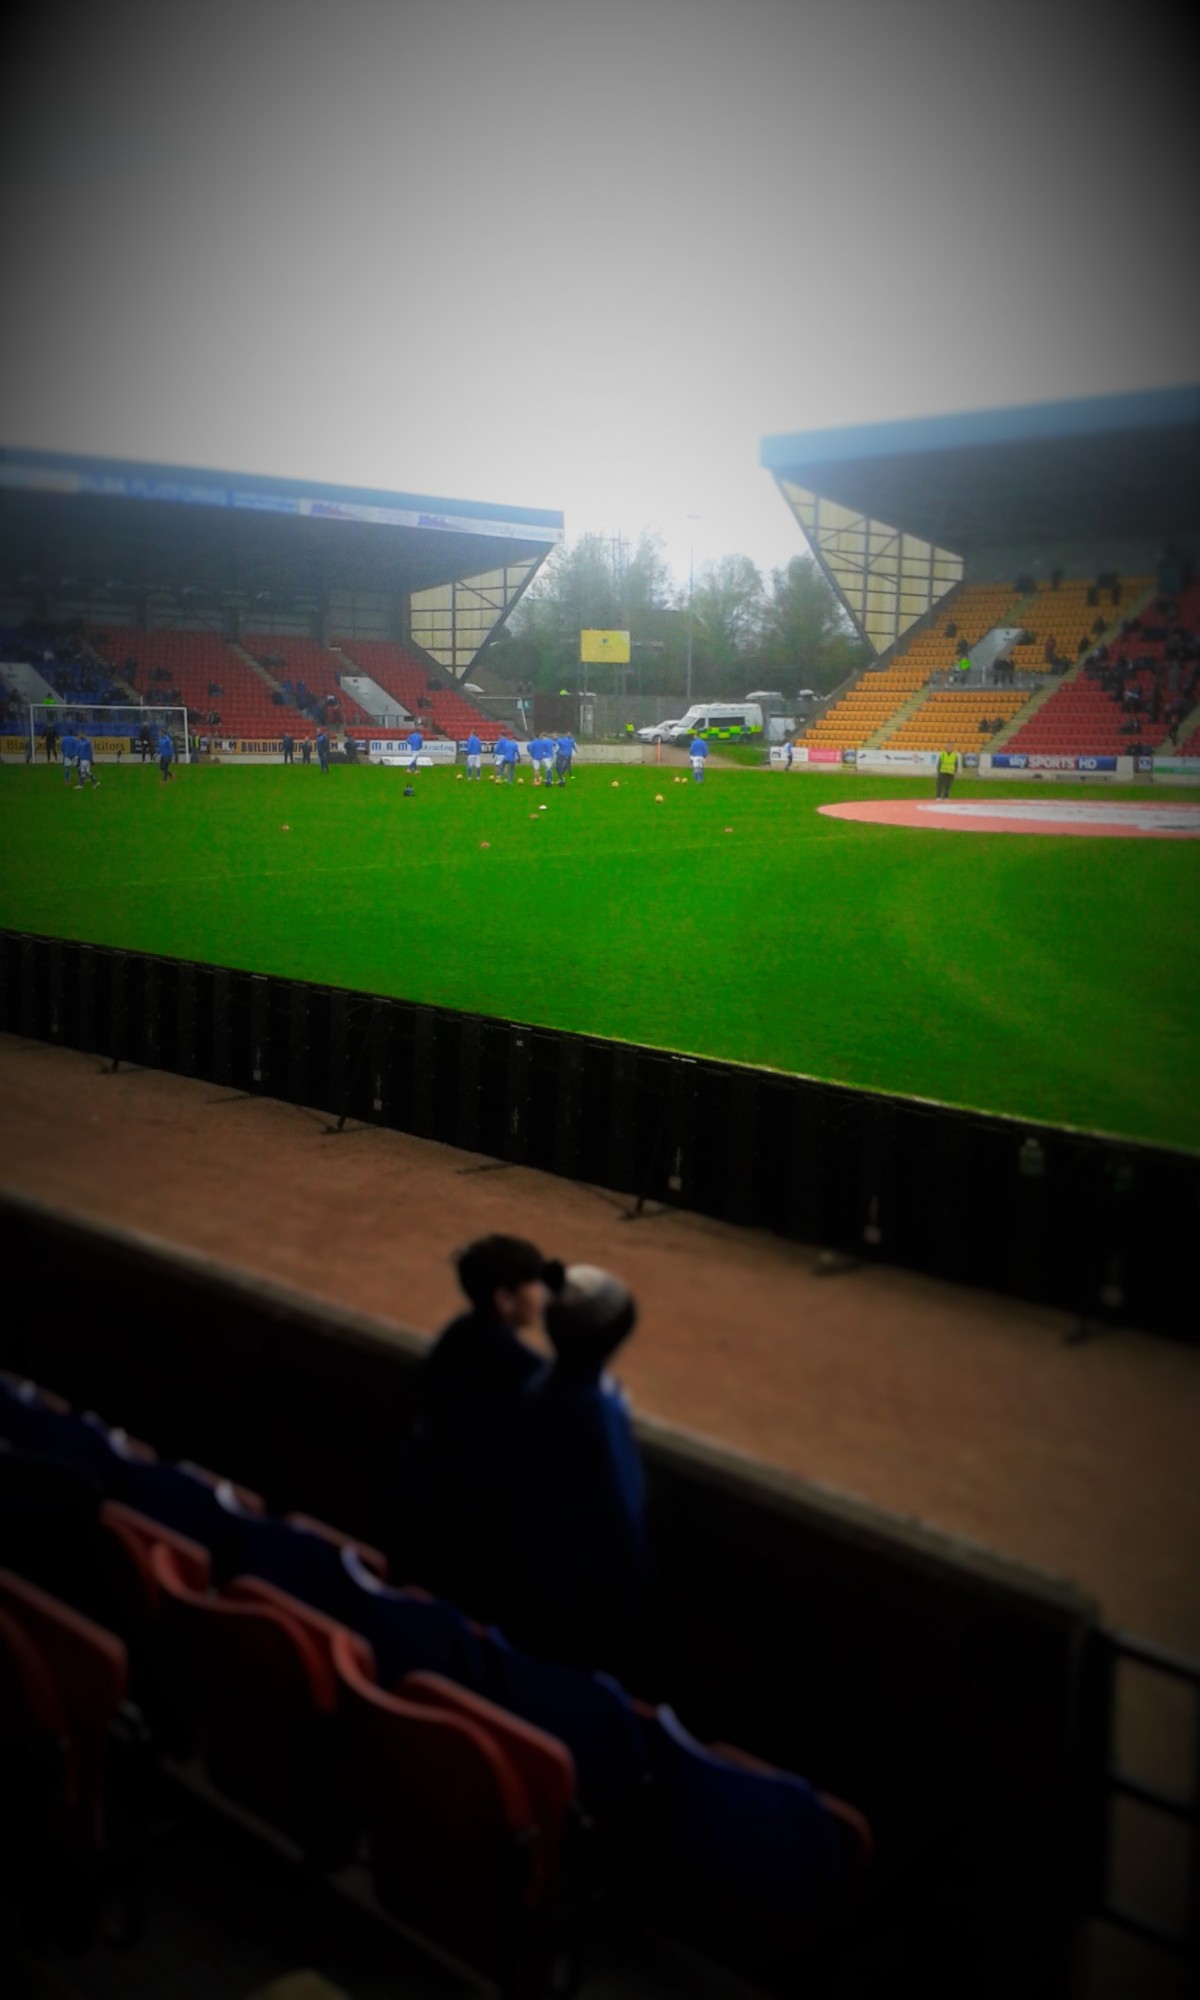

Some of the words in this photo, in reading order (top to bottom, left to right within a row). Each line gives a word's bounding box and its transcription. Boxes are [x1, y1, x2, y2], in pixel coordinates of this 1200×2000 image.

[1008, 754, 1027, 768] sky
[1028, 756, 1075, 769] SPORTS
[1078, 757, 1098, 769] HD
